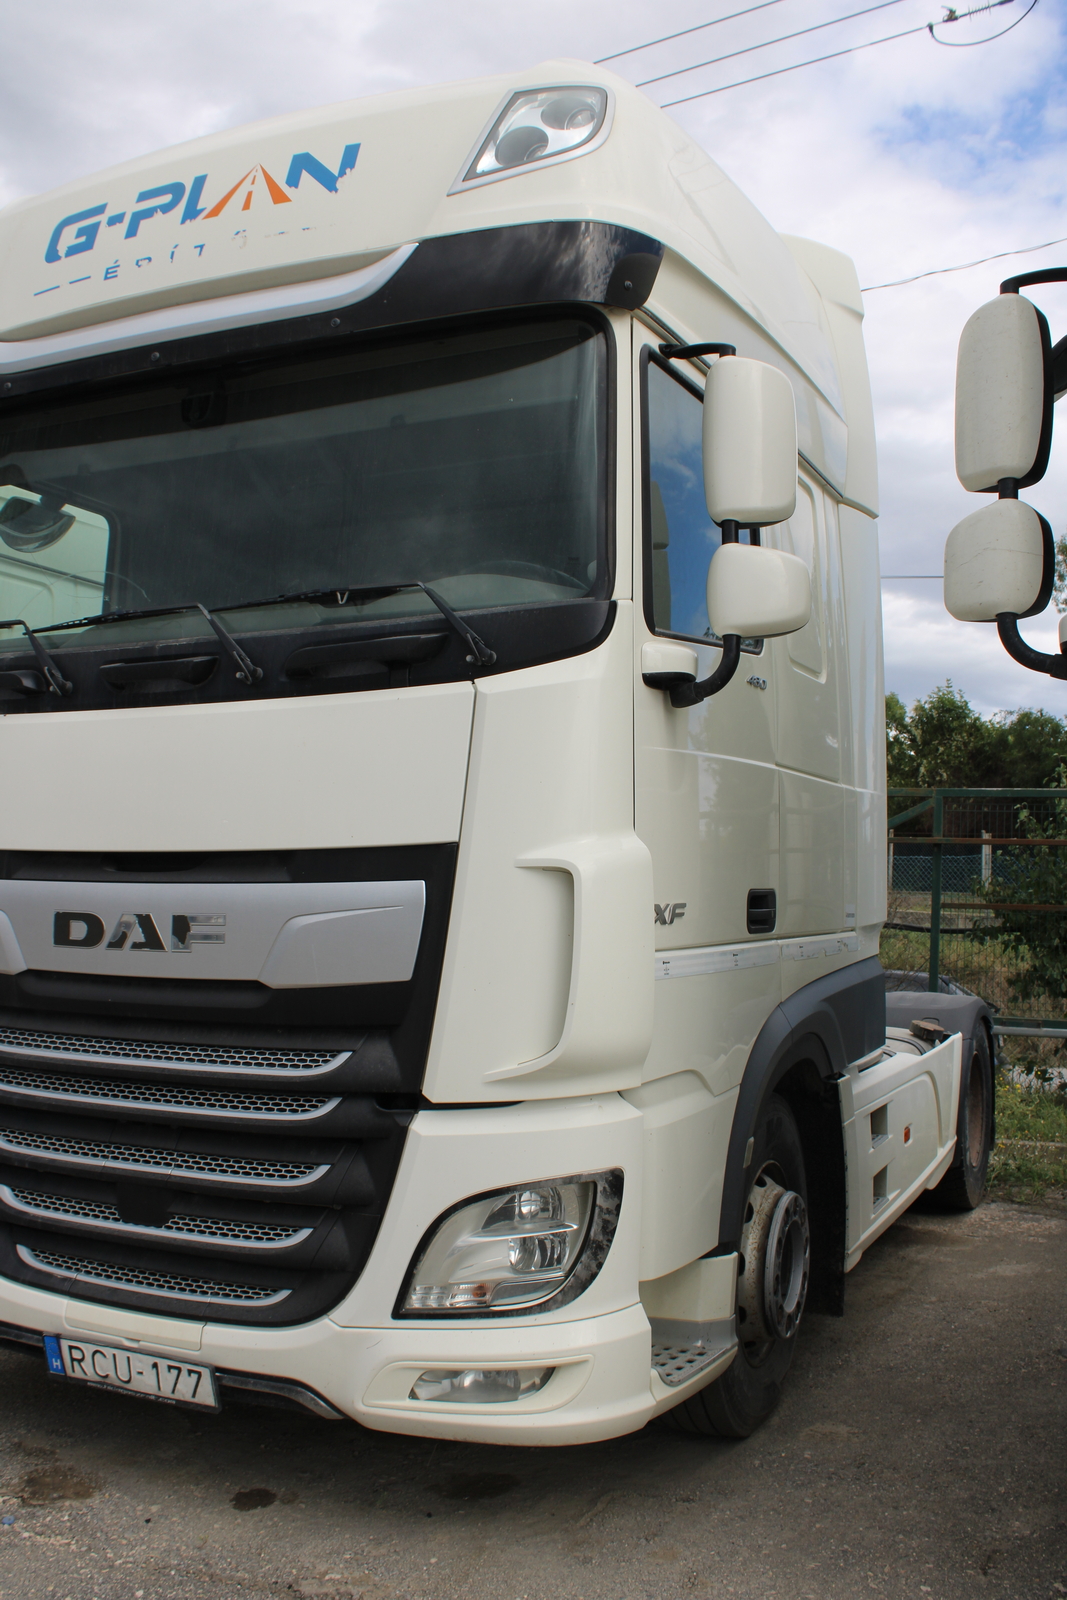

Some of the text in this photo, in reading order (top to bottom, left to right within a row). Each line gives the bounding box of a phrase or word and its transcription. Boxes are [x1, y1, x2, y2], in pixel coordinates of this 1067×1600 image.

[44, 142, 362, 264] G-PLAN
[52, 909, 227, 954] DAF
[653, 902, 687, 926] XF
[52, 1357, 61, 1371] H
[67, 1344, 203, 1399] RCU-177
